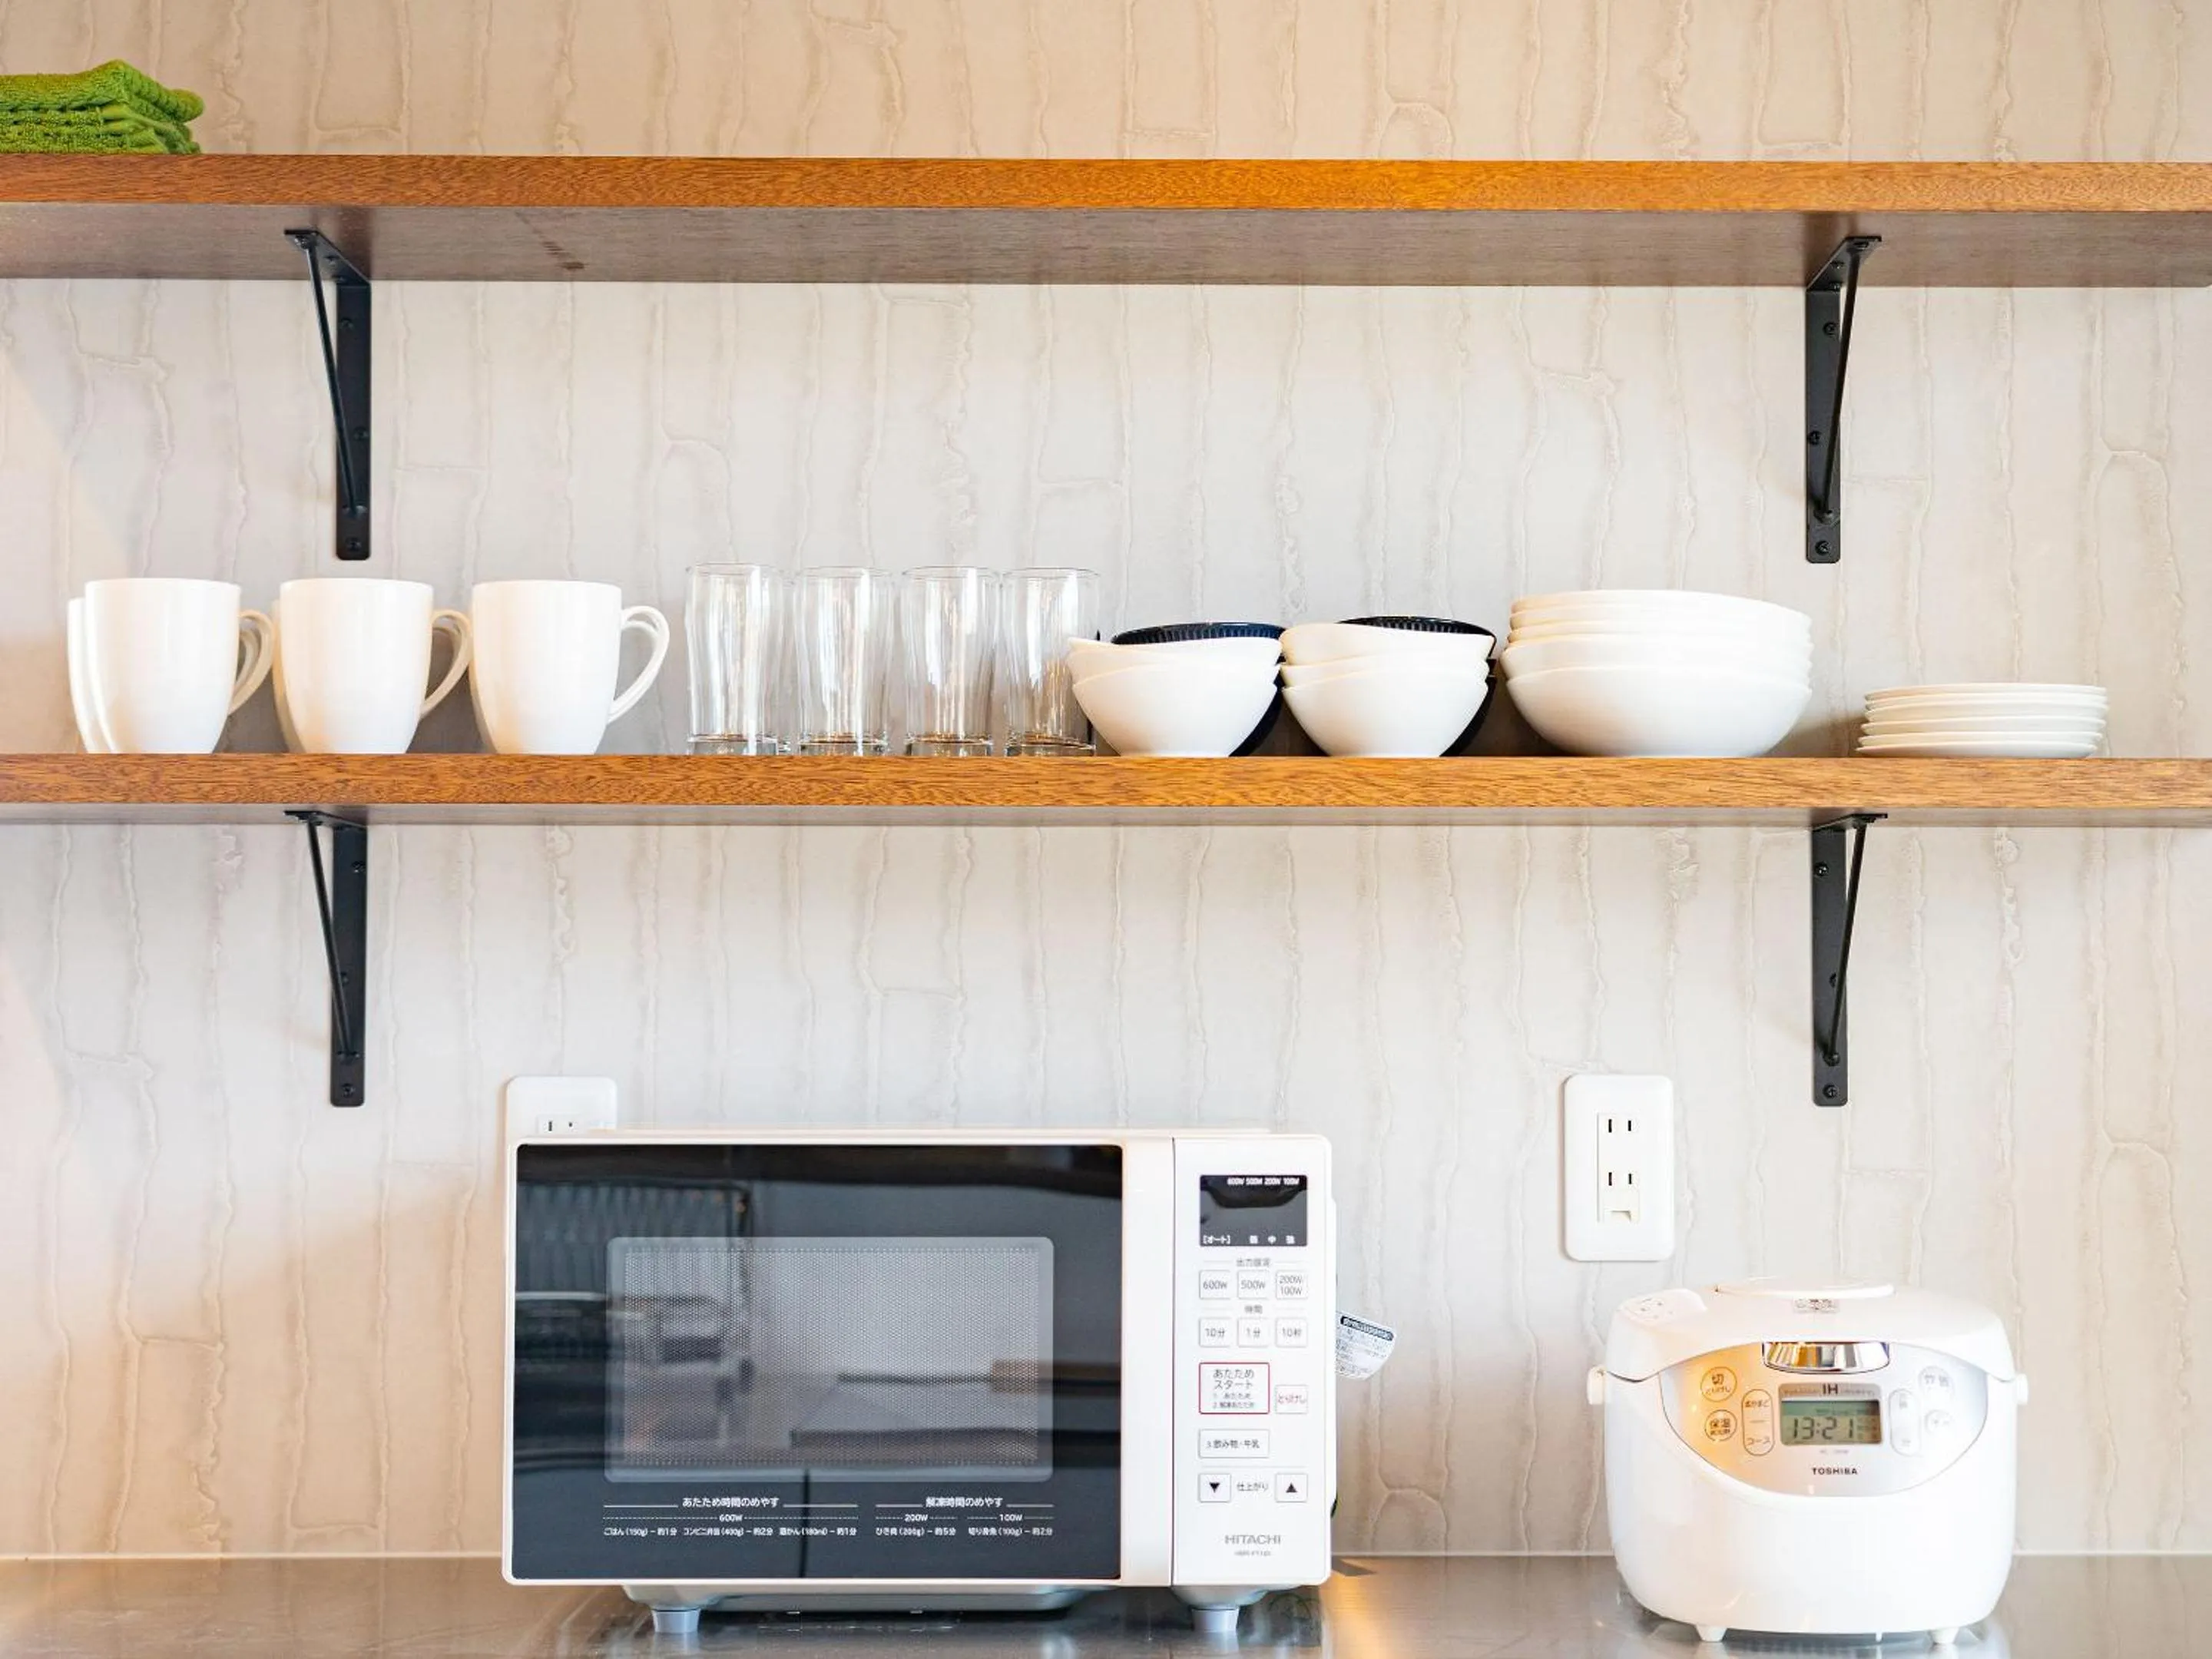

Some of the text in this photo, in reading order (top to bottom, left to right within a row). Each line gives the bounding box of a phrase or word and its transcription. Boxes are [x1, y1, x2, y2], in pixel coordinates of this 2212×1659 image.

[1280, 1275, 1302, 1284] 200W
[1203, 1280, 1227, 1290] 600W
[1241, 1280, 1266, 1290] 500W
[1280, 1286, 1302, 1295] 100W
[1205, 1328, 1225, 1337] 10分
[1213, 1369, 1254, 1379] あたため
[1214, 1380, 1253, 1390] スタート
[1823, 1384, 1838, 1394] IH
[1793, 1416, 1853, 1440] 13:21
[1812, 1467, 1858, 1475] TOSHIBA
[1237, 1482, 1268, 1492] 仕上がり
[682, 1497, 779, 1507] あたため時間のめやす
[1225, 1535, 1281, 1545] HITACHI
